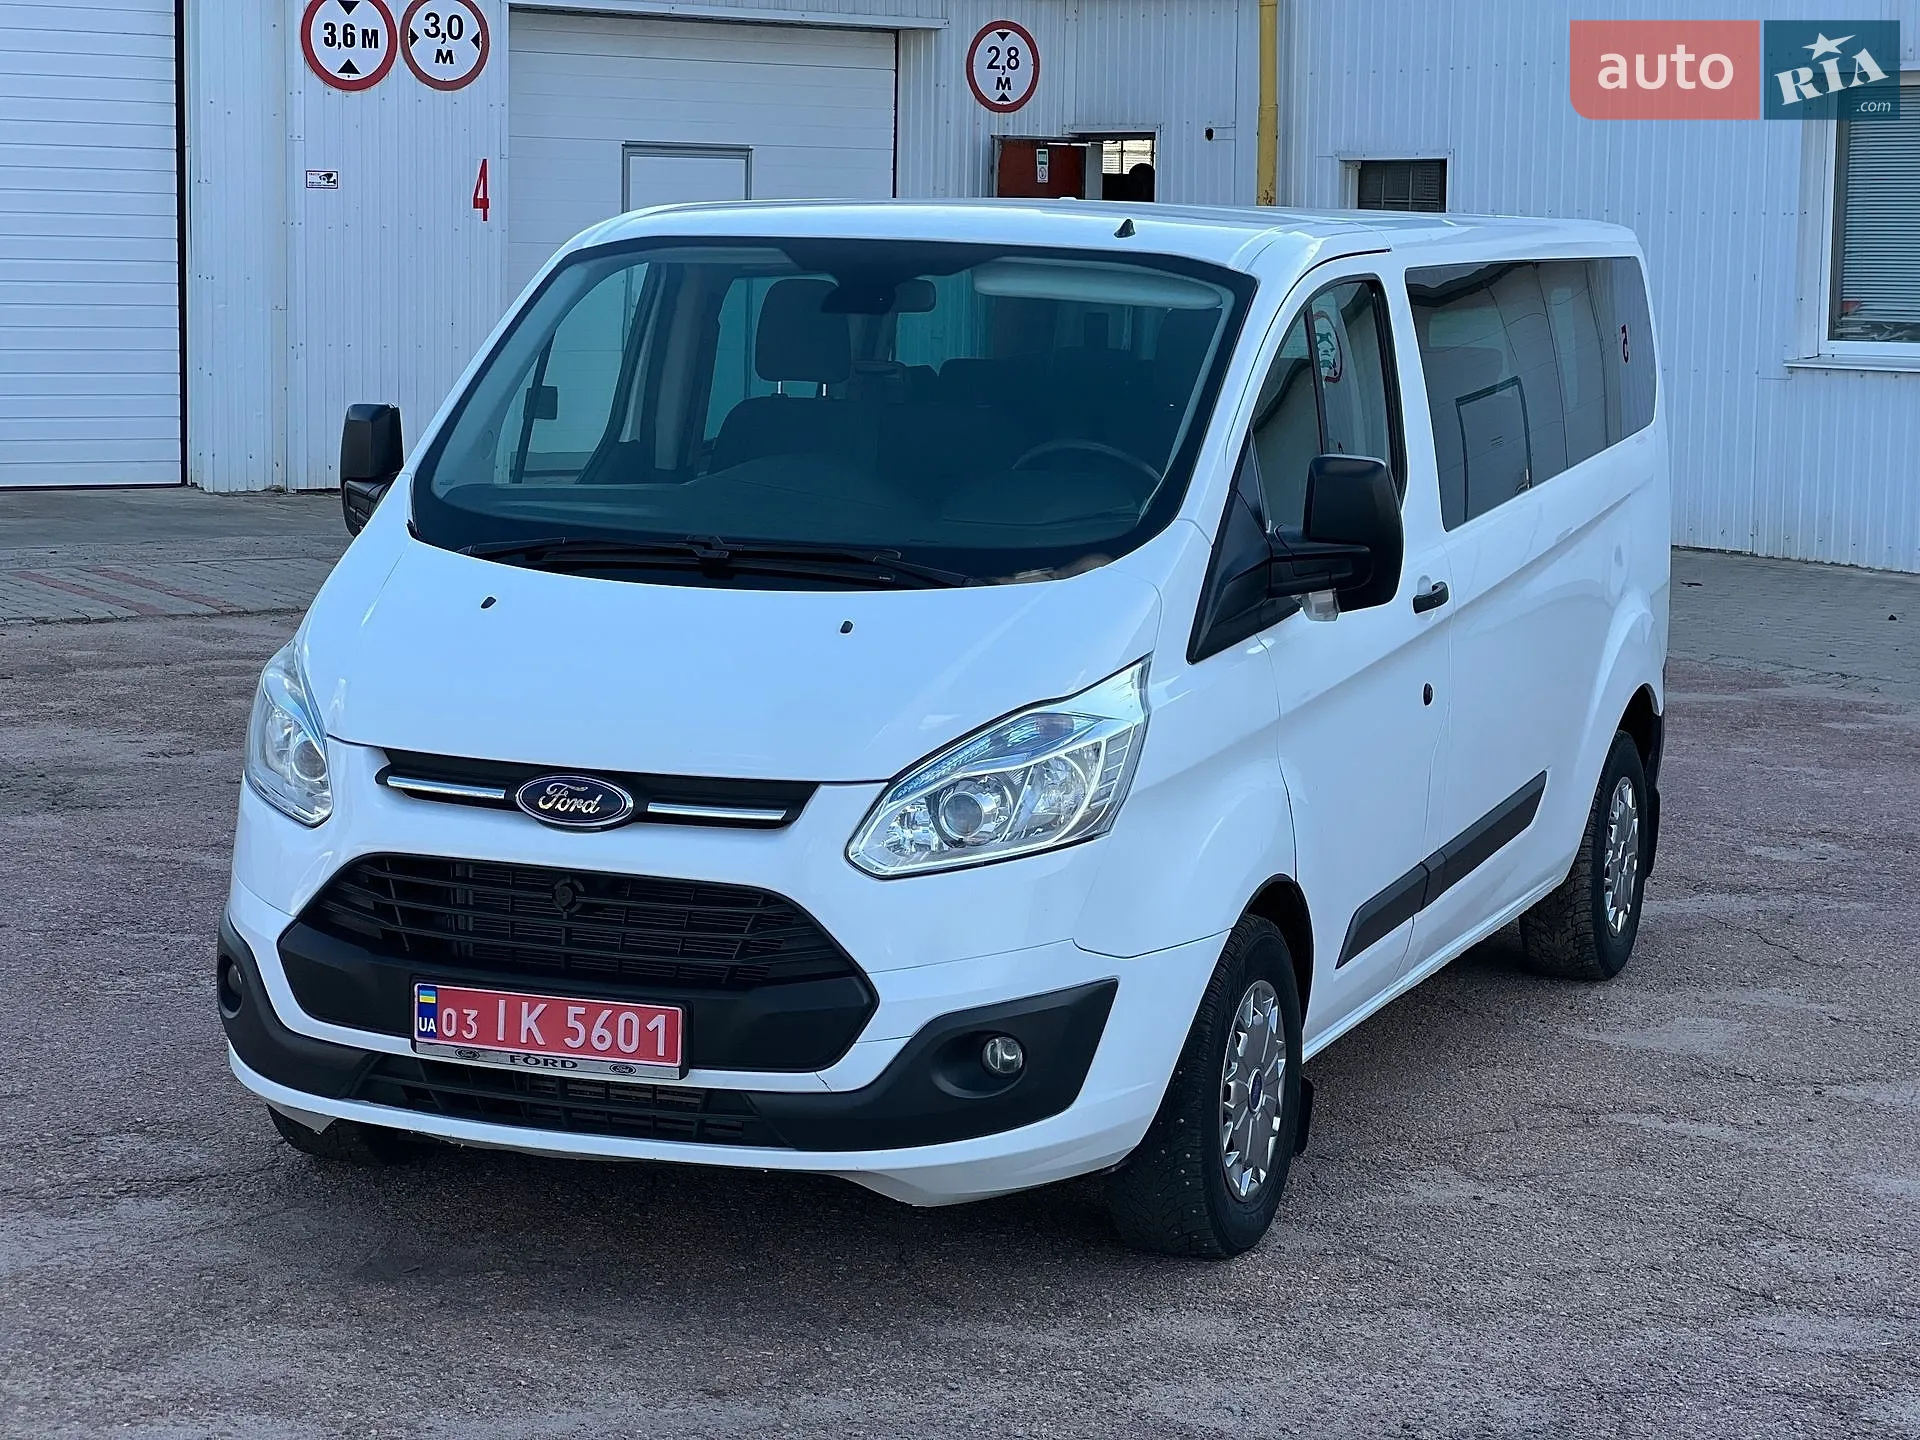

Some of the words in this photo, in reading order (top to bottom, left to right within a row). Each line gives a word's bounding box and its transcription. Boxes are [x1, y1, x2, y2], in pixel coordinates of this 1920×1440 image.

[323, 22, 356, 50] 3,6
[424, 12, 464, 44] 3,0
[986, 45, 1020, 75] 2,8
[473, 158, 490, 222] 4
[538, 782, 603, 814] Ford
[418, 1017, 437, 1033] UA
[441, 1007, 479, 1039] 03
[563, 1006, 666, 1057] 5601
[509, 1054, 578, 1069] FORD
